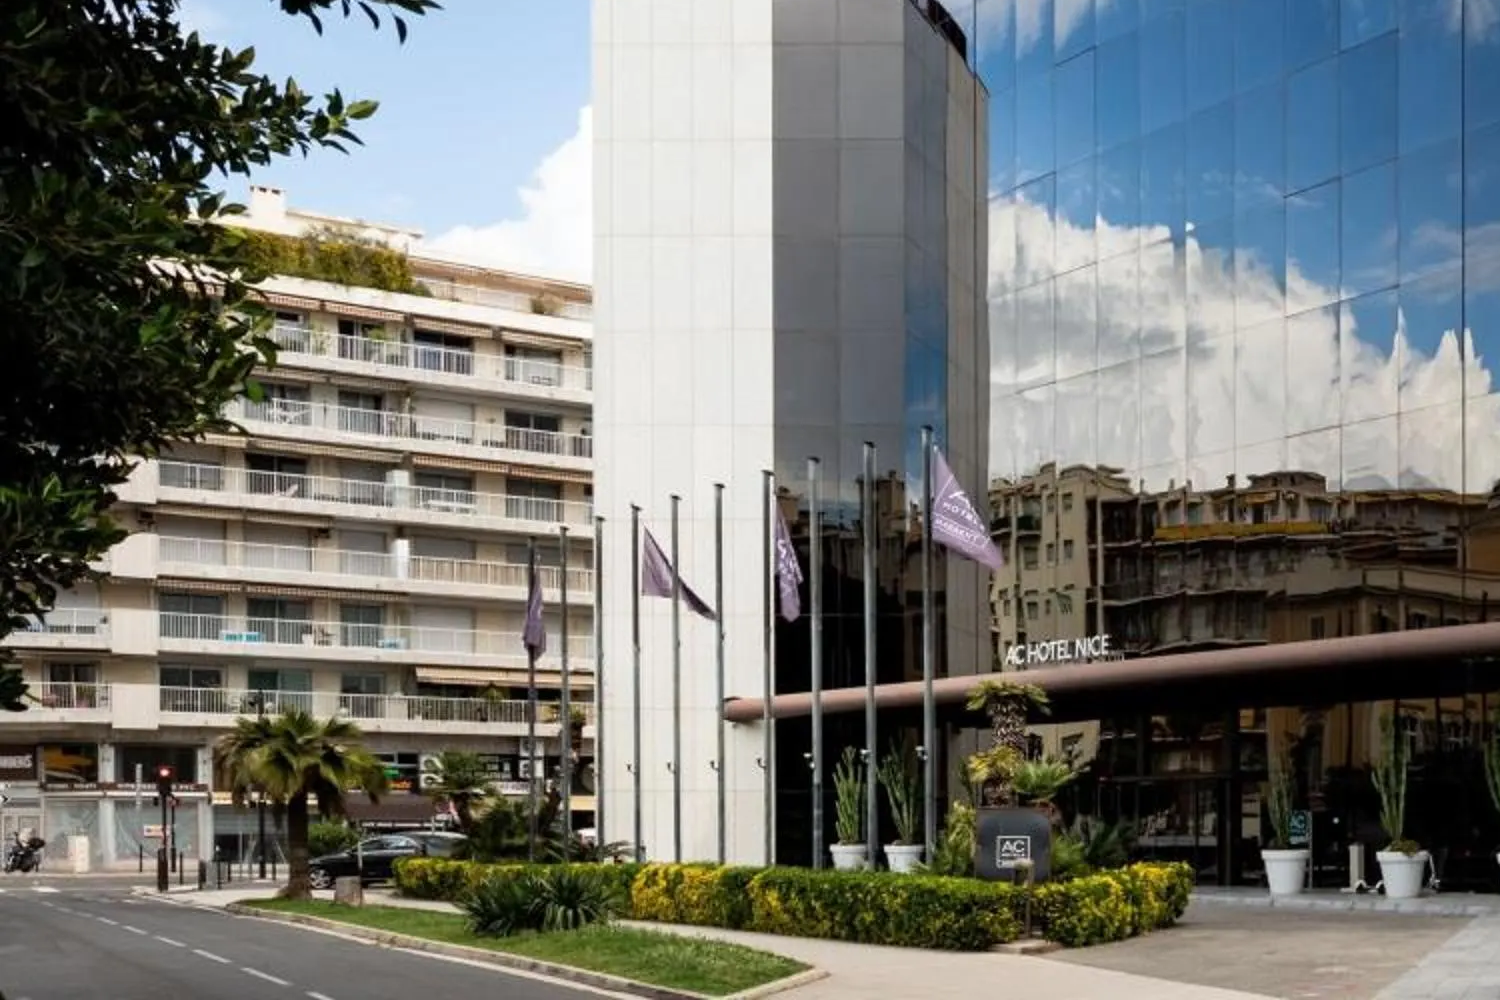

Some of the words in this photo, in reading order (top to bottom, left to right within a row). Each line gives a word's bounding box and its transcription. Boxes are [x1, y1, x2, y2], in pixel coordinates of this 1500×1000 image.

[1005, 645, 1025, 665] AC
[1027, 640, 1072, 662] HOTEL
[1075, 635, 1110, 659] NICE
[1001, 840, 1024, 853] AC
